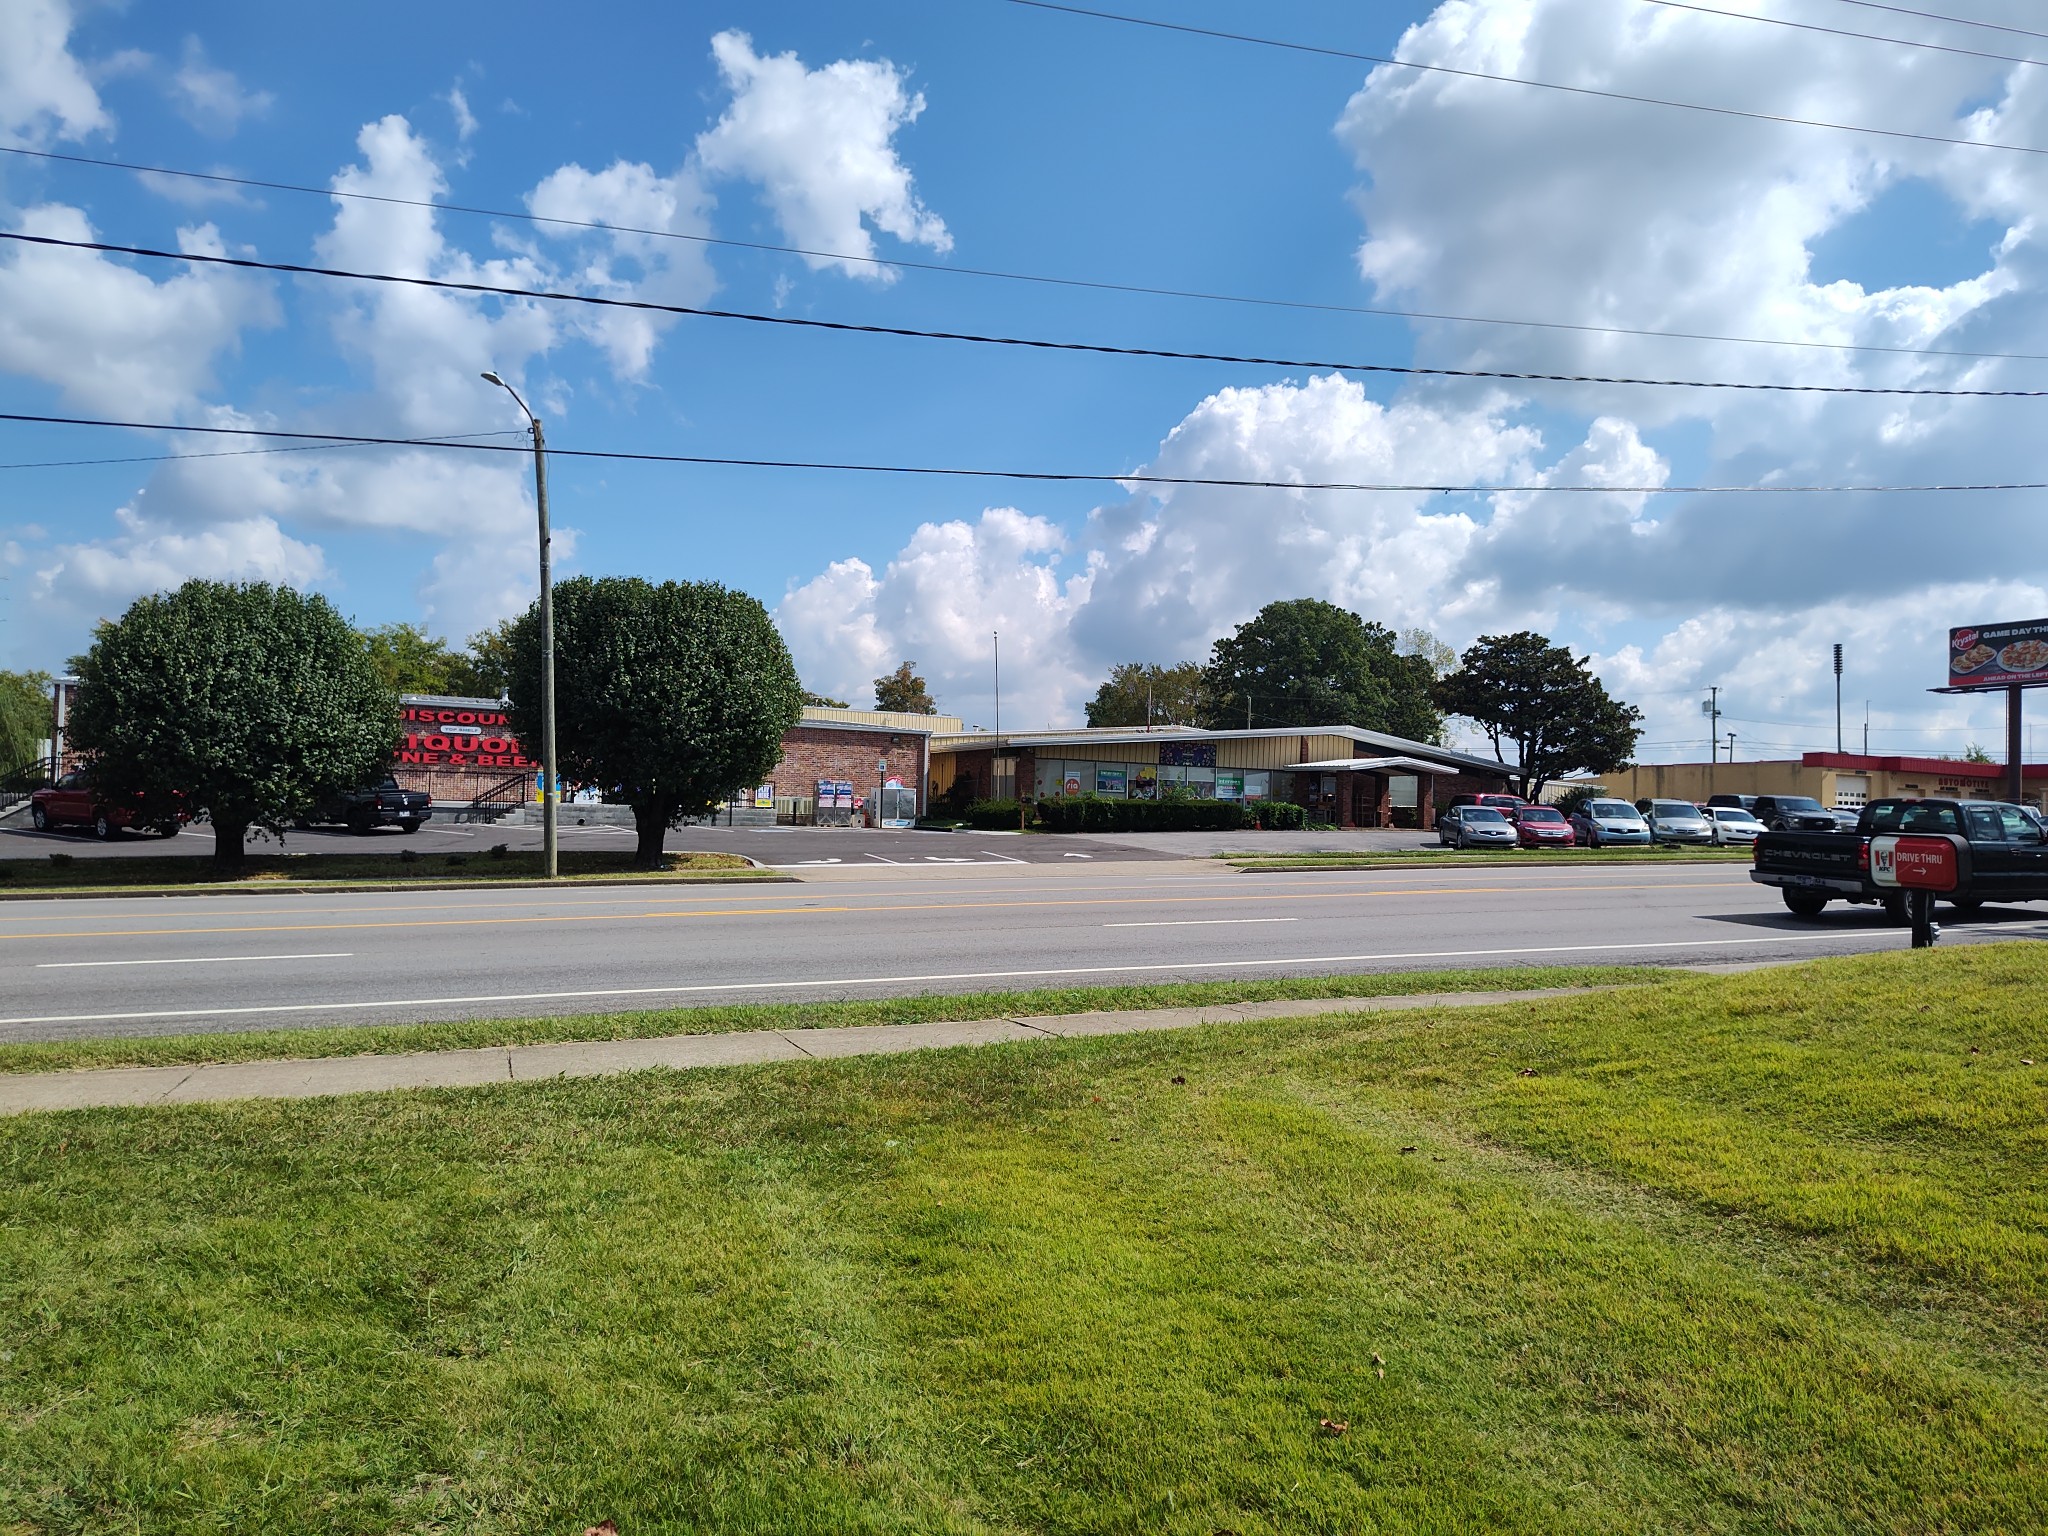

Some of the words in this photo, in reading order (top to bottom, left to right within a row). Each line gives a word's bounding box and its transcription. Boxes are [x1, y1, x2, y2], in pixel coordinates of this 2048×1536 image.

[1951, 630, 1979, 648] Krystal
[1983, 629, 2010, 639] GAME
[2011, 627, 2033, 636] DAY
[1983, 674, 2007, 682] AHEAD
[449, 753, 467, 765] &
[1938, 777, 1989, 789] AUTOMOTIVE
[1764, 849, 1851, 863] CHEVROLET
[1896, 852, 1920, 863] DRIVE
[1920, 853, 1943, 865] THRU
